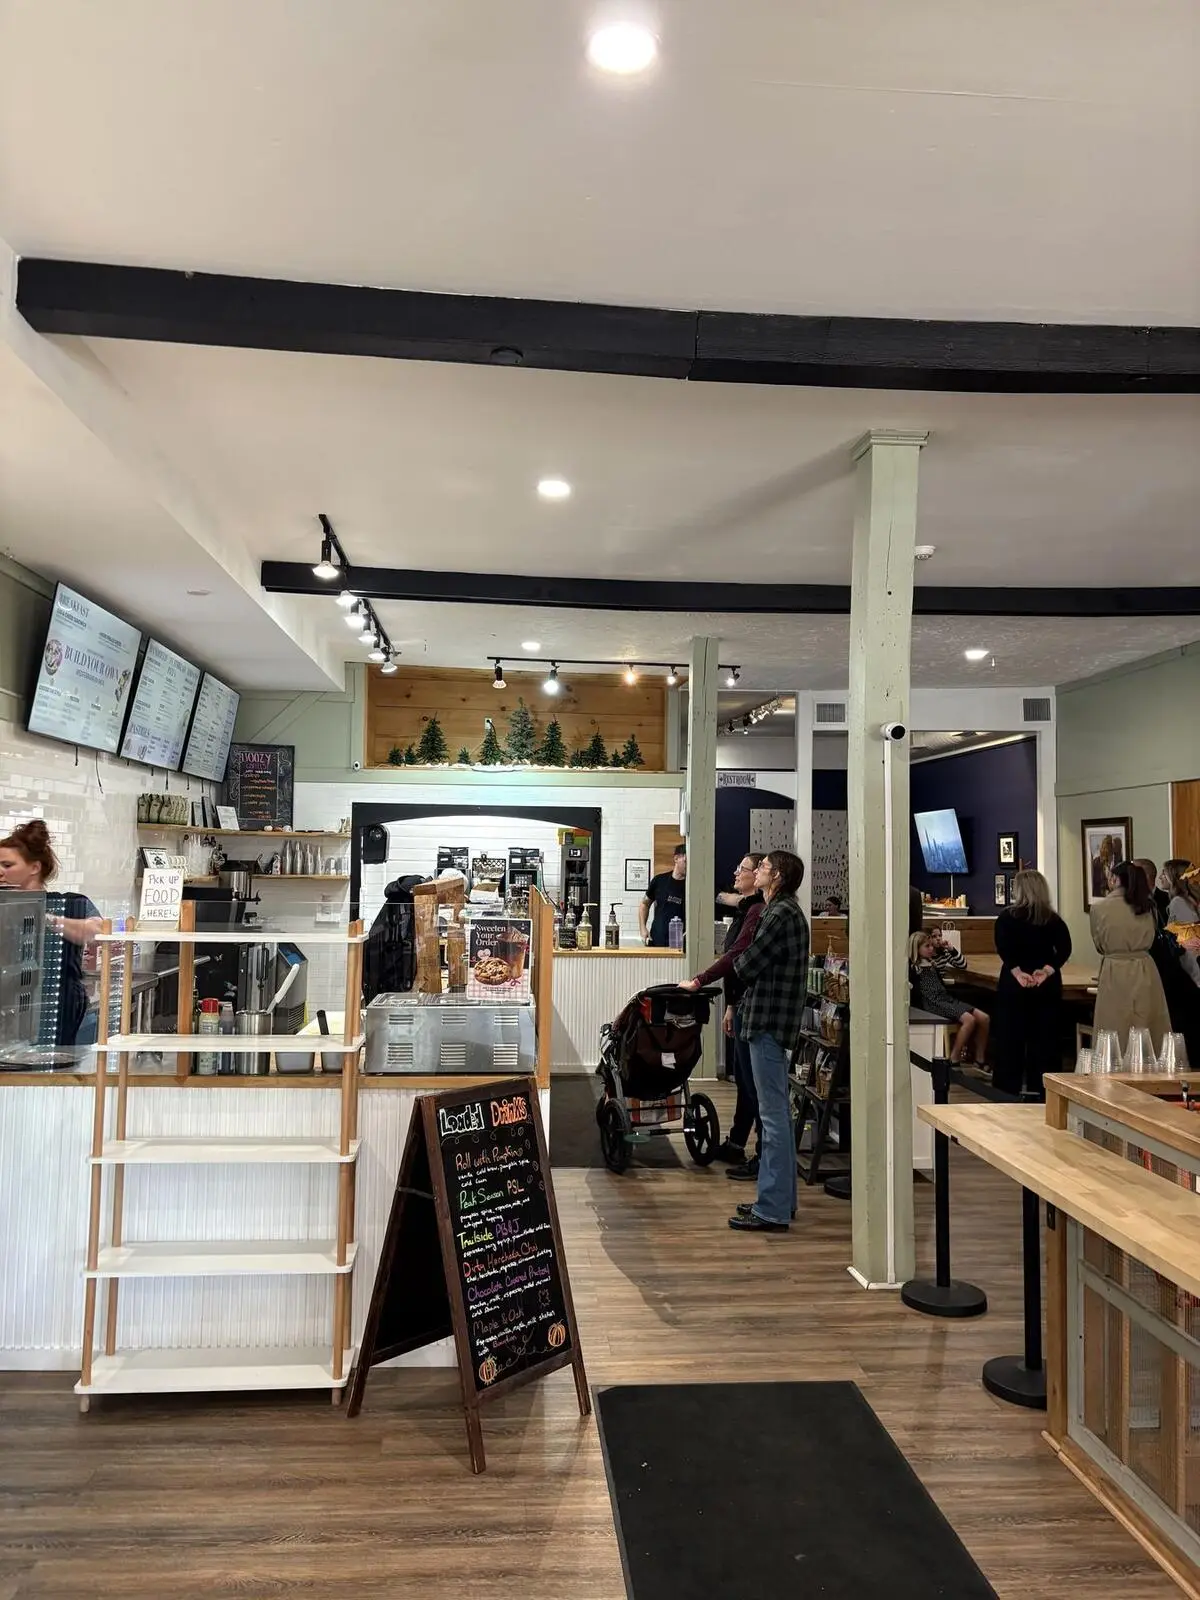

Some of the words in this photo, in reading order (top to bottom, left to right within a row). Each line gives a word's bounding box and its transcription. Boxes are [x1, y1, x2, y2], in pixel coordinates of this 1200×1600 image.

[65, 645, 86, 667] BUILD
[87, 656, 104, 674] YOUR
[105, 665, 119, 680] OWN
[723, 773, 751, 785] RESTROOM
[168, 875, 179, 884] UP
[145, 888, 179, 905] FOOD
[147, 909, 172, 918] HERE!
[475, 924, 506, 932] Sweeten
[439, 1103, 485, 1136] Loaded
[490, 1097, 528, 1126] Drinks
[456, 1152, 472, 1170] Roll
[474, 1148, 491, 1167] with
[492, 1145, 518, 1163] Pumpkin
[476, 1168, 486, 1176] cold
[500, 1162, 518, 1172] pumpkin
[518, 1159, 530, 1167] spice
[461, 1180, 472, 1188] cold
[460, 1190, 477, 1210] Peak
[477, 1188, 504, 1204] Season
[507, 1179, 525, 1196] PSL
[460, 1212, 479, 1223] pumpkin
[464, 1219, 483, 1228] whipped
[457, 1227, 494, 1249] Trailside
[495, 1218, 520, 1238] PB&J
[463, 1259, 486, 1277] Dirty
[521, 1242, 538, 1255] Chai
[468, 1281, 503, 1302] Chocolate
[505, 1271, 527, 1287] Covered
[472, 1310, 482, 1318] cold
[484, 1305, 500, 1313] foam
[473, 1320, 499, 1336] Maple
[508, 1306, 524, 1322] Oak
[478, 1346, 489, 1356] with
[492, 1335, 517, 1348] Bourbon
